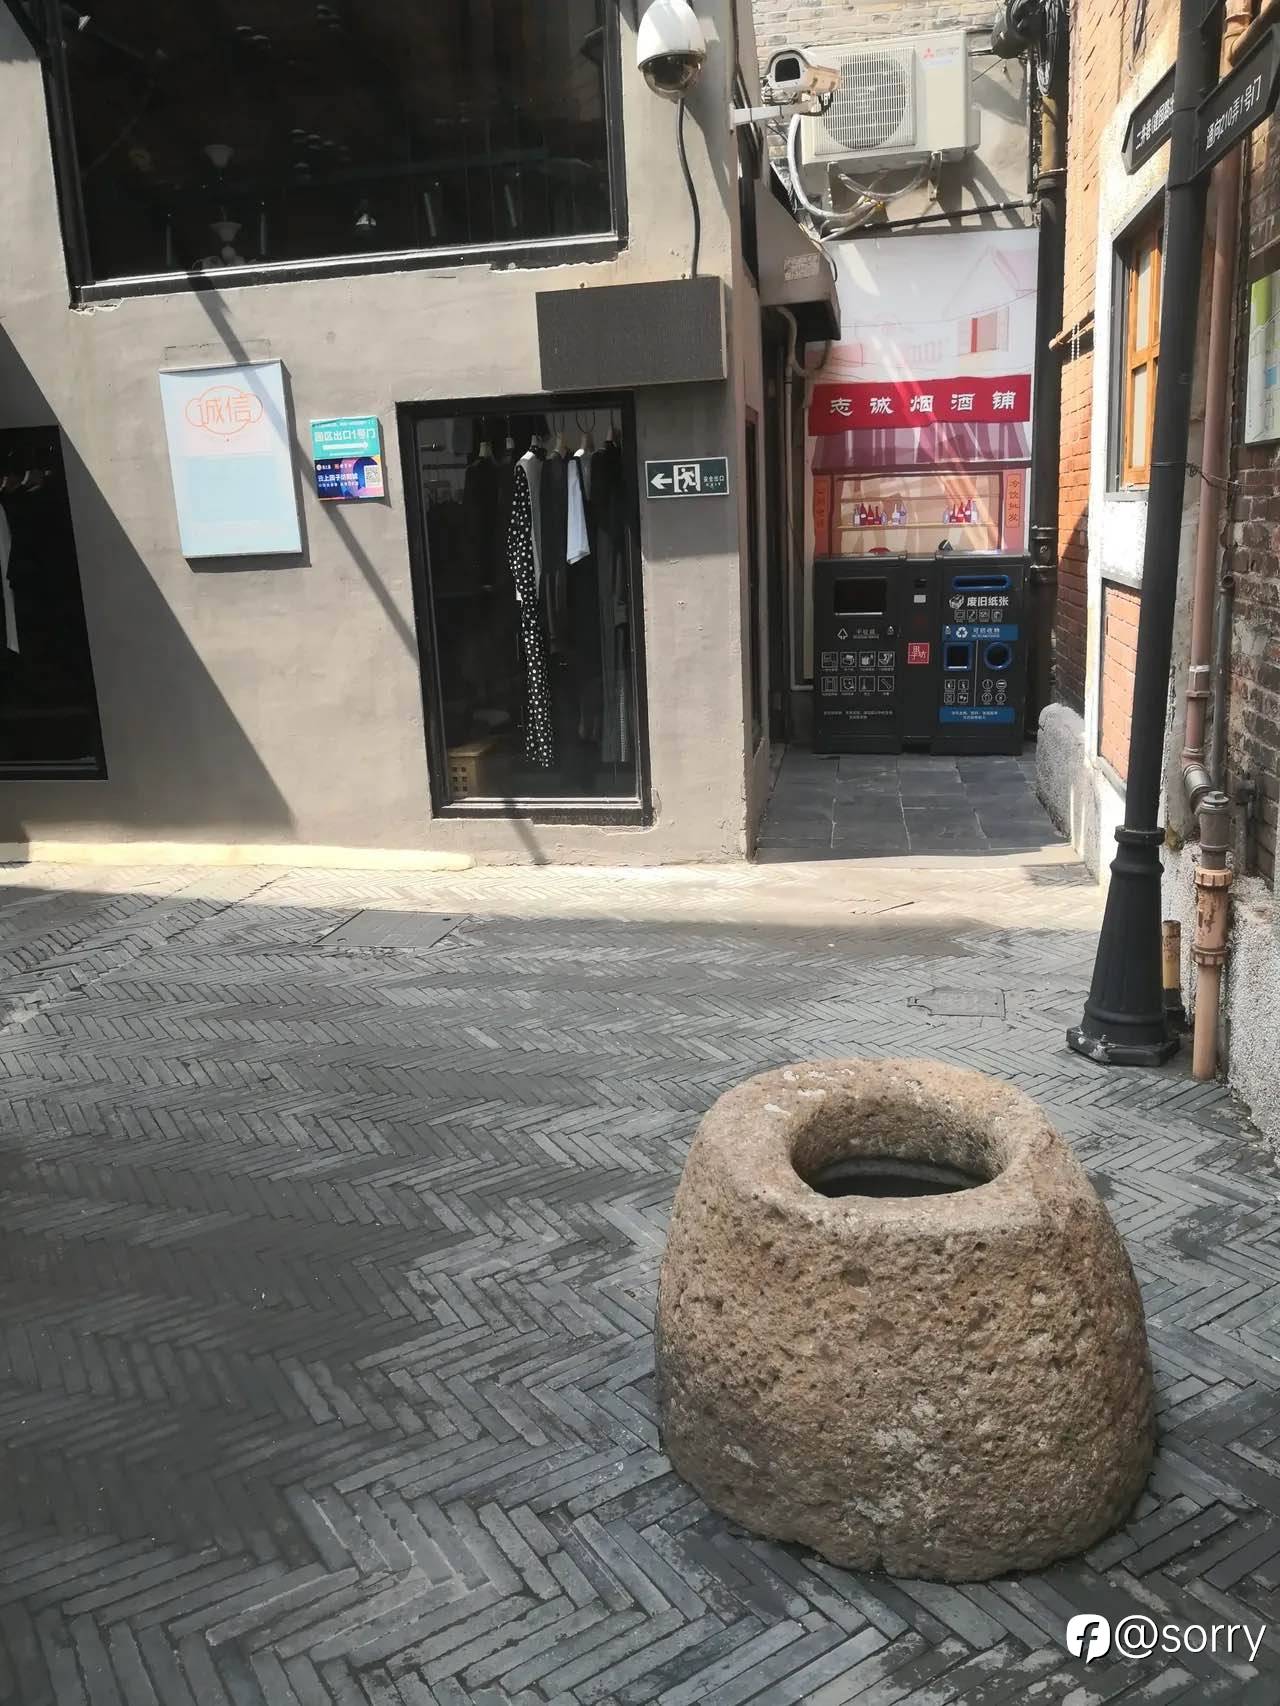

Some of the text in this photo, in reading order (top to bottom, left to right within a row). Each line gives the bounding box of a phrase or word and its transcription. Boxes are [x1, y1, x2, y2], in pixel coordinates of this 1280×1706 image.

[830, 391, 1016, 416] 志诚烟酒铺
[967, 595, 1009, 607] 废旧纸张
